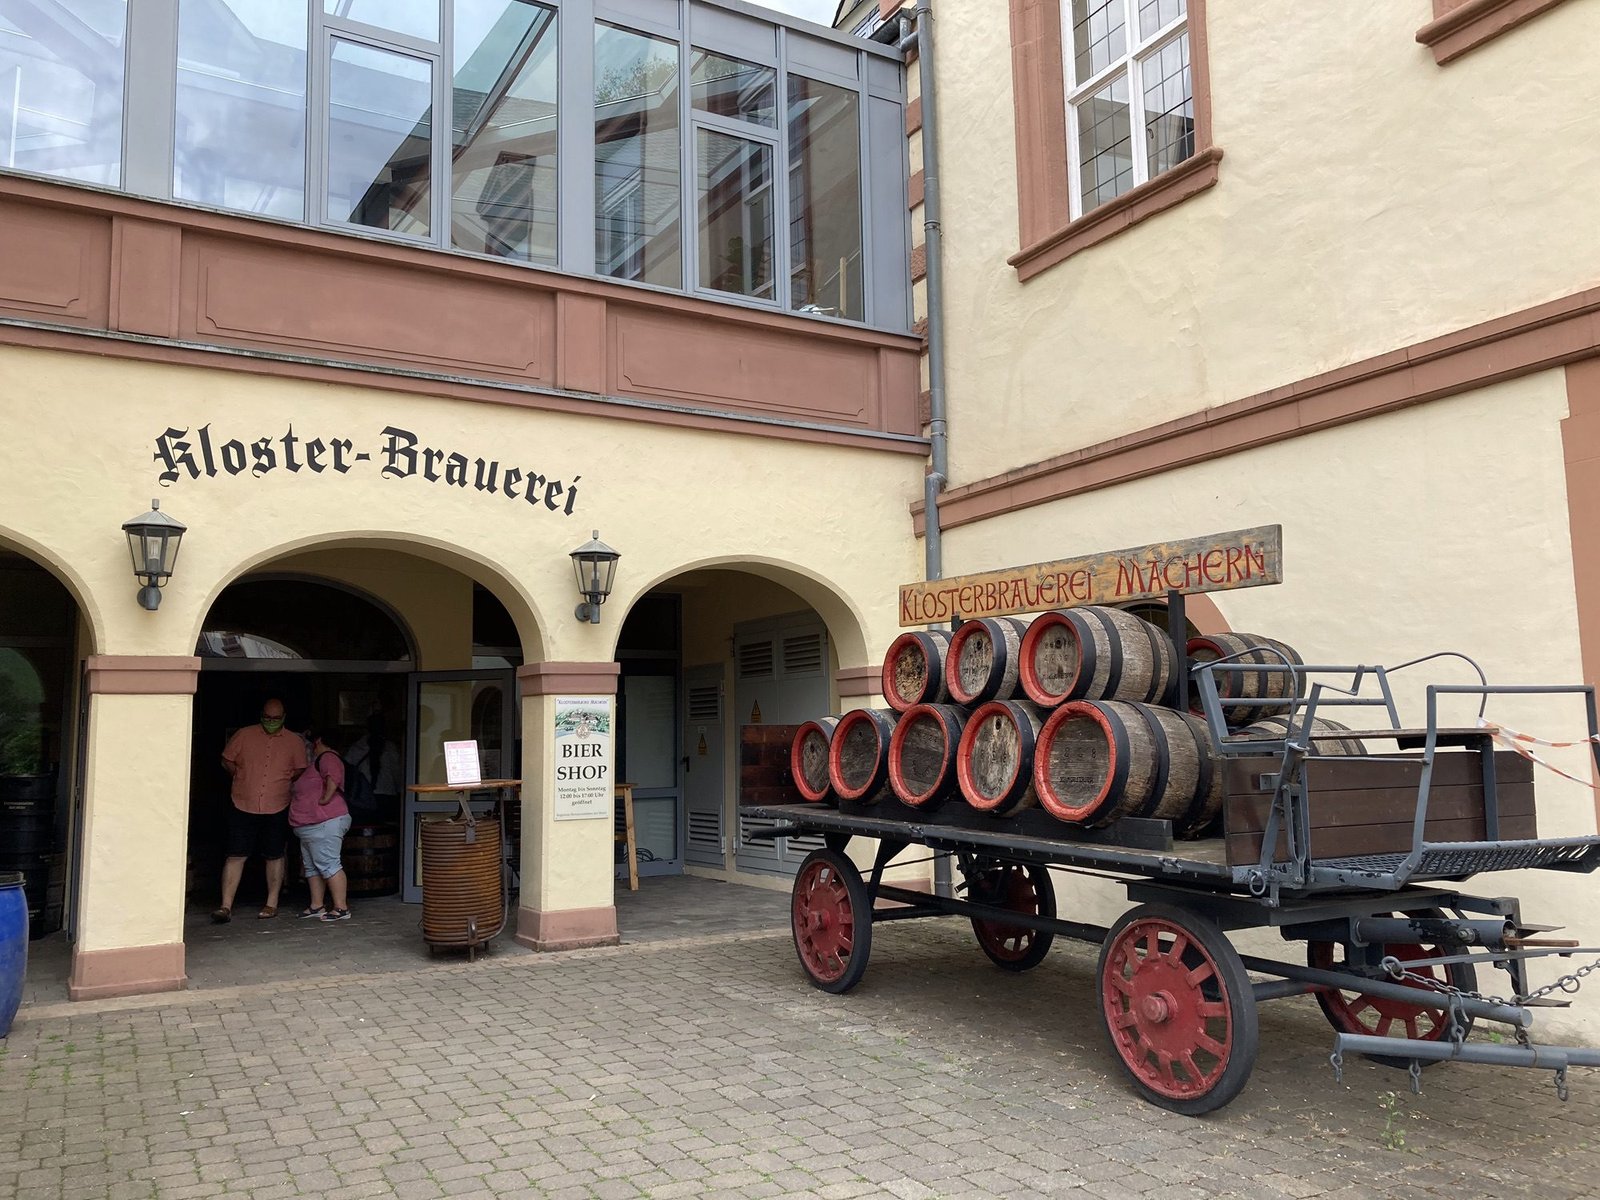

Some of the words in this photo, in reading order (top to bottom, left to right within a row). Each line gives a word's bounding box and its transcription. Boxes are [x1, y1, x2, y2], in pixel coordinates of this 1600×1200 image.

[153, 422, 581, 516] Kloster-Brauerei
[902, 570, 1093, 622] KLOSTERBRAUEREI
[1115, 541, 1266, 597] MACHERN
[557, 765, 607, 781] SHOP
[562, 743, 603, 758] BIER
